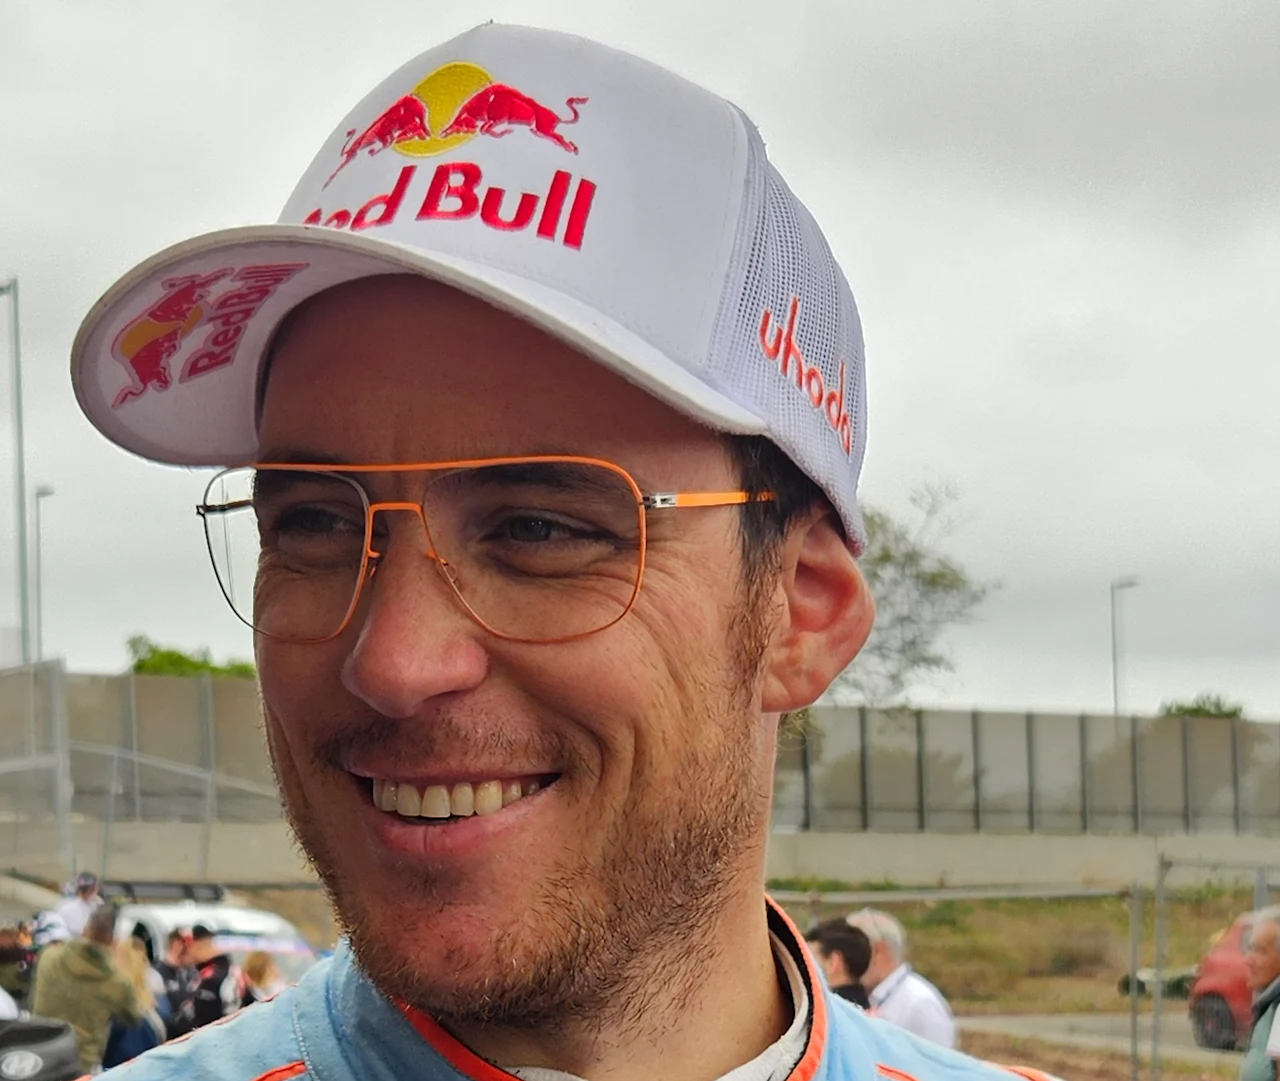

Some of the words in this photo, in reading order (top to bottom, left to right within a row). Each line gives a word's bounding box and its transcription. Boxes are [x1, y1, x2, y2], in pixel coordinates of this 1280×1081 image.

[416, 161, 597, 251] Bull
[214, 262, 311, 311] Bull
[187, 306, 255, 378] Red
[758, 295, 852, 458] uhoda
